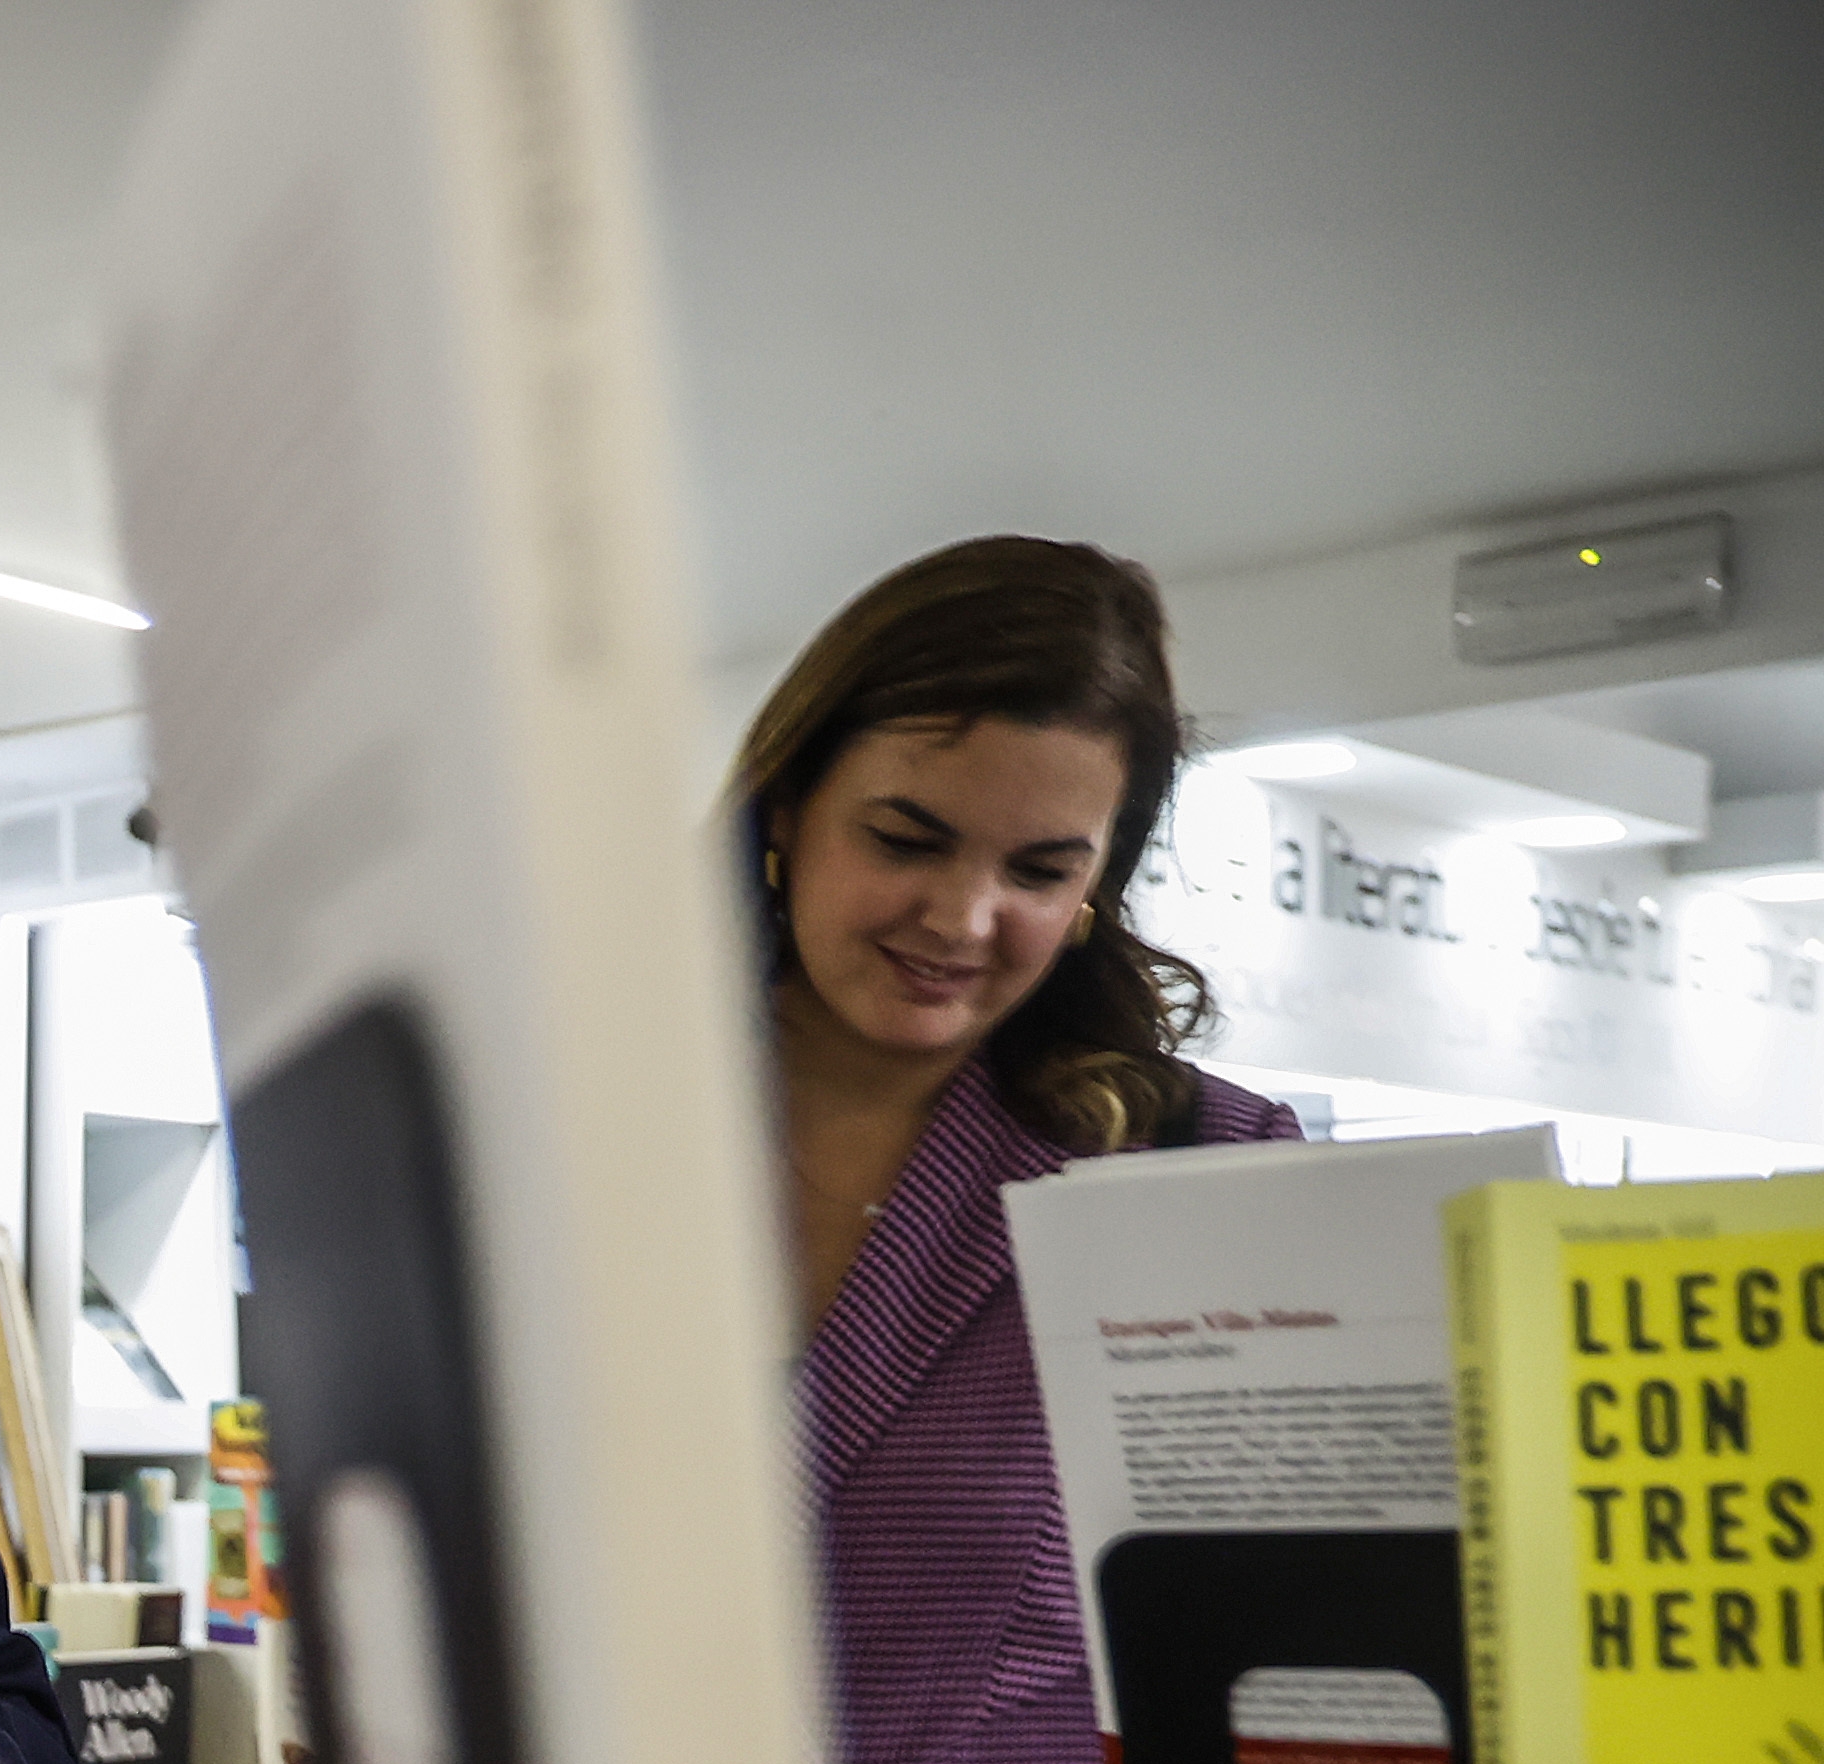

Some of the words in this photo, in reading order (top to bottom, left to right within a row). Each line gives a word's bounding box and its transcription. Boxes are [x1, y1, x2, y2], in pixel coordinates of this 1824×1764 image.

[1577, 1376, 1749, 1459] CON
[1576, 1477, 1815, 1565] TRES
[1588, 1586, 1824, 1672] HERI
